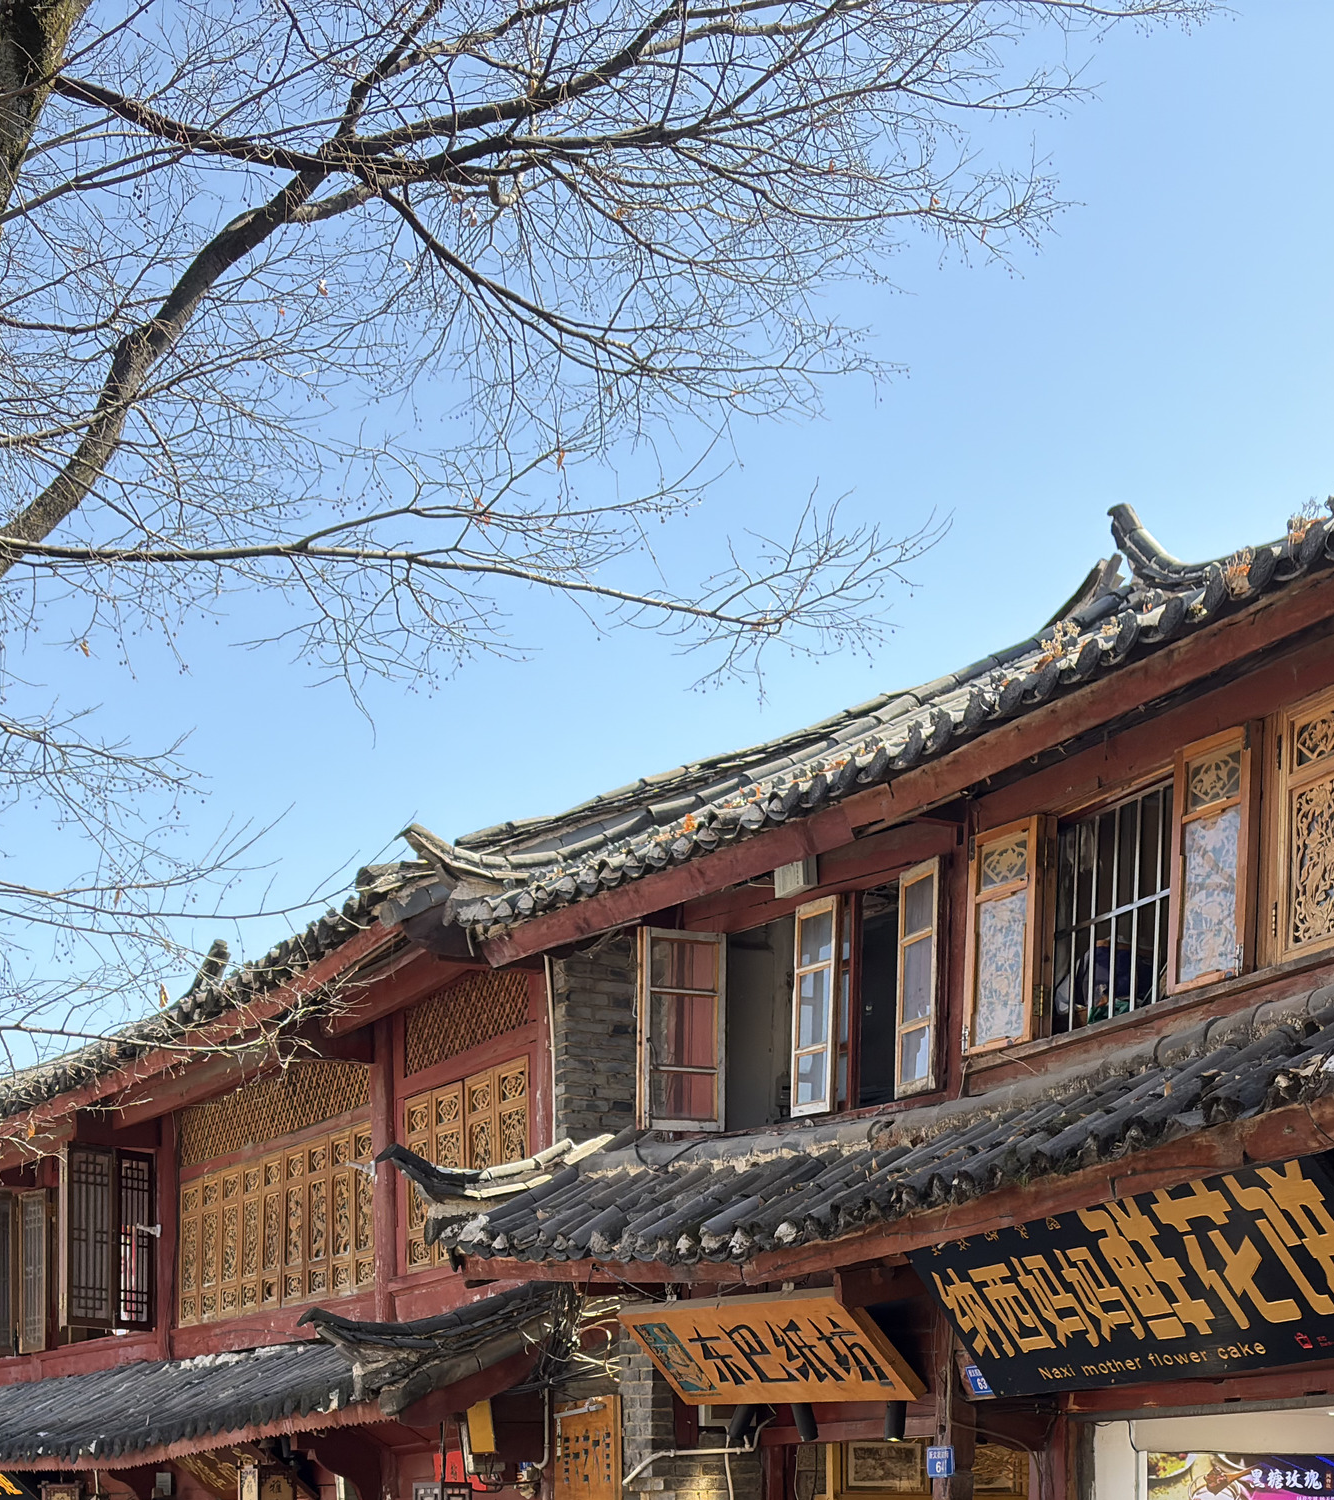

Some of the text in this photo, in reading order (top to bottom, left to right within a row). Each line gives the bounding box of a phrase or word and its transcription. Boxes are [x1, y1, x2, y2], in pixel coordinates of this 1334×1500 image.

[687, 1315, 896, 1389] 东巴纸坊
[1037, 1340, 1267, 1382] Naxi mother flower cake
[977, 1378, 988, 1390] 63
[1250, 1469, 1323, 1490] 黑糖玫瑰
